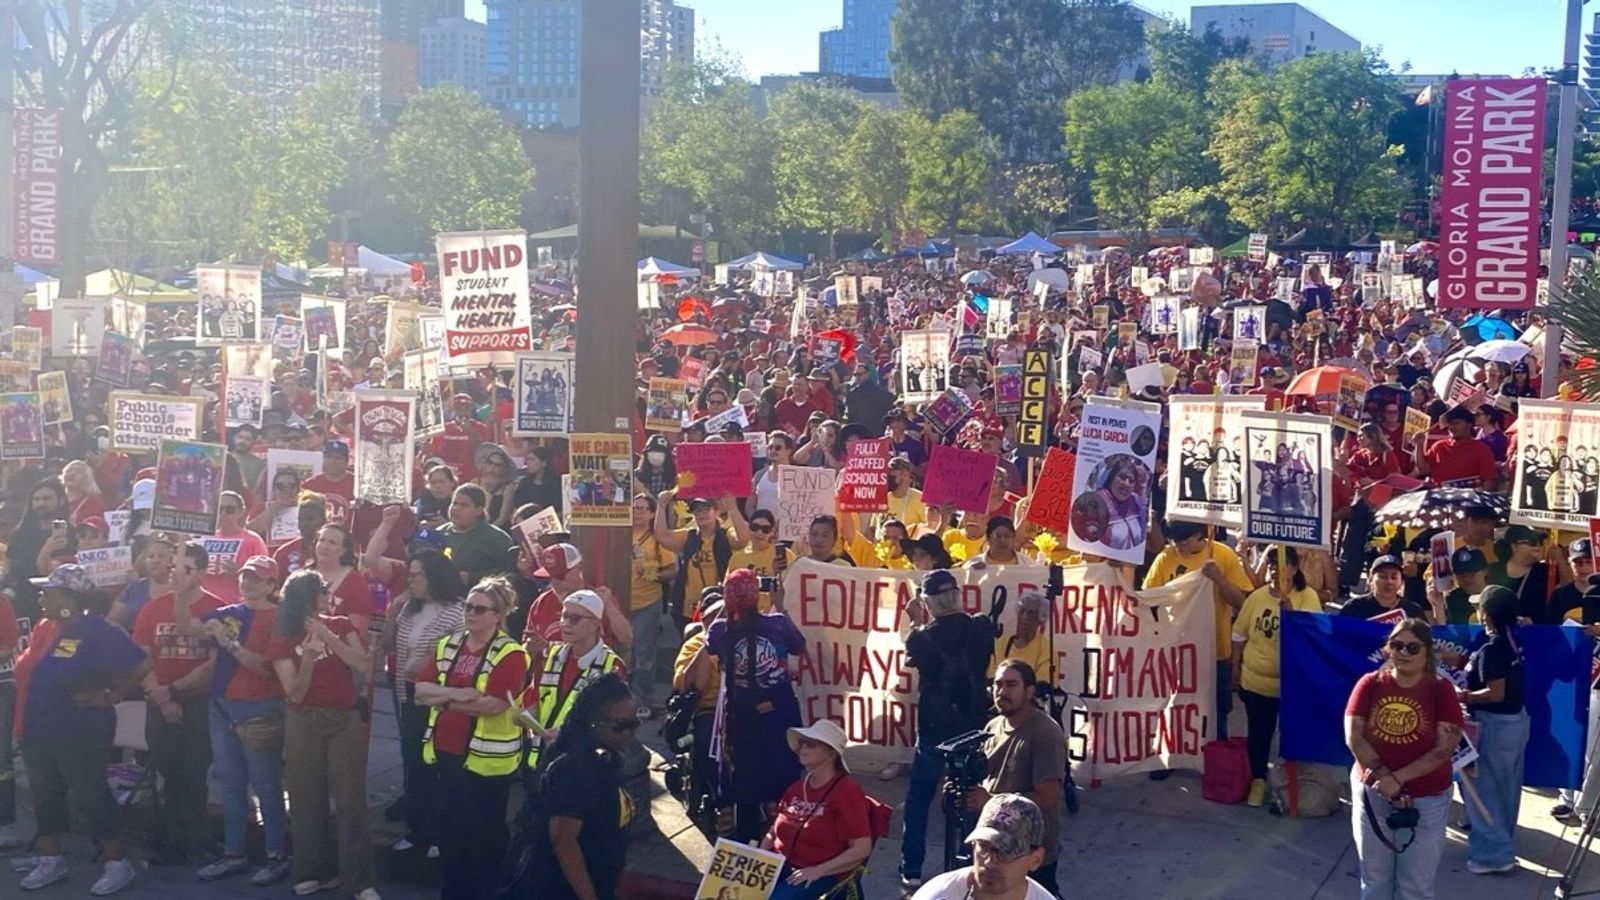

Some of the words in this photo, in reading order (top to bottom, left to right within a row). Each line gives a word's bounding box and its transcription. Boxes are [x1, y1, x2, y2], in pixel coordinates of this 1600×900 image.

[1451, 86, 1476, 187] MOLINA
[1480, 84, 1537, 174] PARK
[19, 112, 30, 180] MOLINA
[32, 113, 57, 173] PARK
[18, 191, 29, 257] GLORIA
[30, 181, 56, 260] GRAND
[1447, 202, 1469, 299] GLORIA
[1475, 187, 1530, 302] GRAND
[443, 244, 522, 276] FUND
[456, 277, 509, 291] STUDENT
[450, 292, 517, 311] MENTAL
[456, 311, 516, 329] HEALTH
[450, 333, 528, 350] SUPPORTS
[117, 400, 167, 413] Public
[1024, 352, 1046, 444] ACCE
[116, 411, 175, 424] schools
[521, 420, 536, 429] OUR
[115, 421, 141, 432] are
[143, 424, 192, 436] under
[572, 440, 592, 454] WE
[594, 440, 629, 454] CAN'T
[854, 442, 880, 454] FULLY
[572, 455, 608, 470] WAIT
[847, 457, 885, 470] STAFFED
[783, 469, 833, 491] FUND
[844, 472, 887, 485] SCHOOLS
[788, 490, 820, 505] THE
[853, 486, 877, 499] NOW
[1252, 521, 1273, 536] OUR
[1275, 523, 1317, 540] FUTURE.
[205, 540, 237, 552] VOTE
[1255, 615, 1279, 632] ACC
[795, 641, 912, 694] ALWAYS
[1083, 644, 1198, 699] DEMAND
[1070, 703, 1207, 765] STUDENTS!
[713, 849, 777, 879] STRIKE
[708, 862, 773, 891] READY
